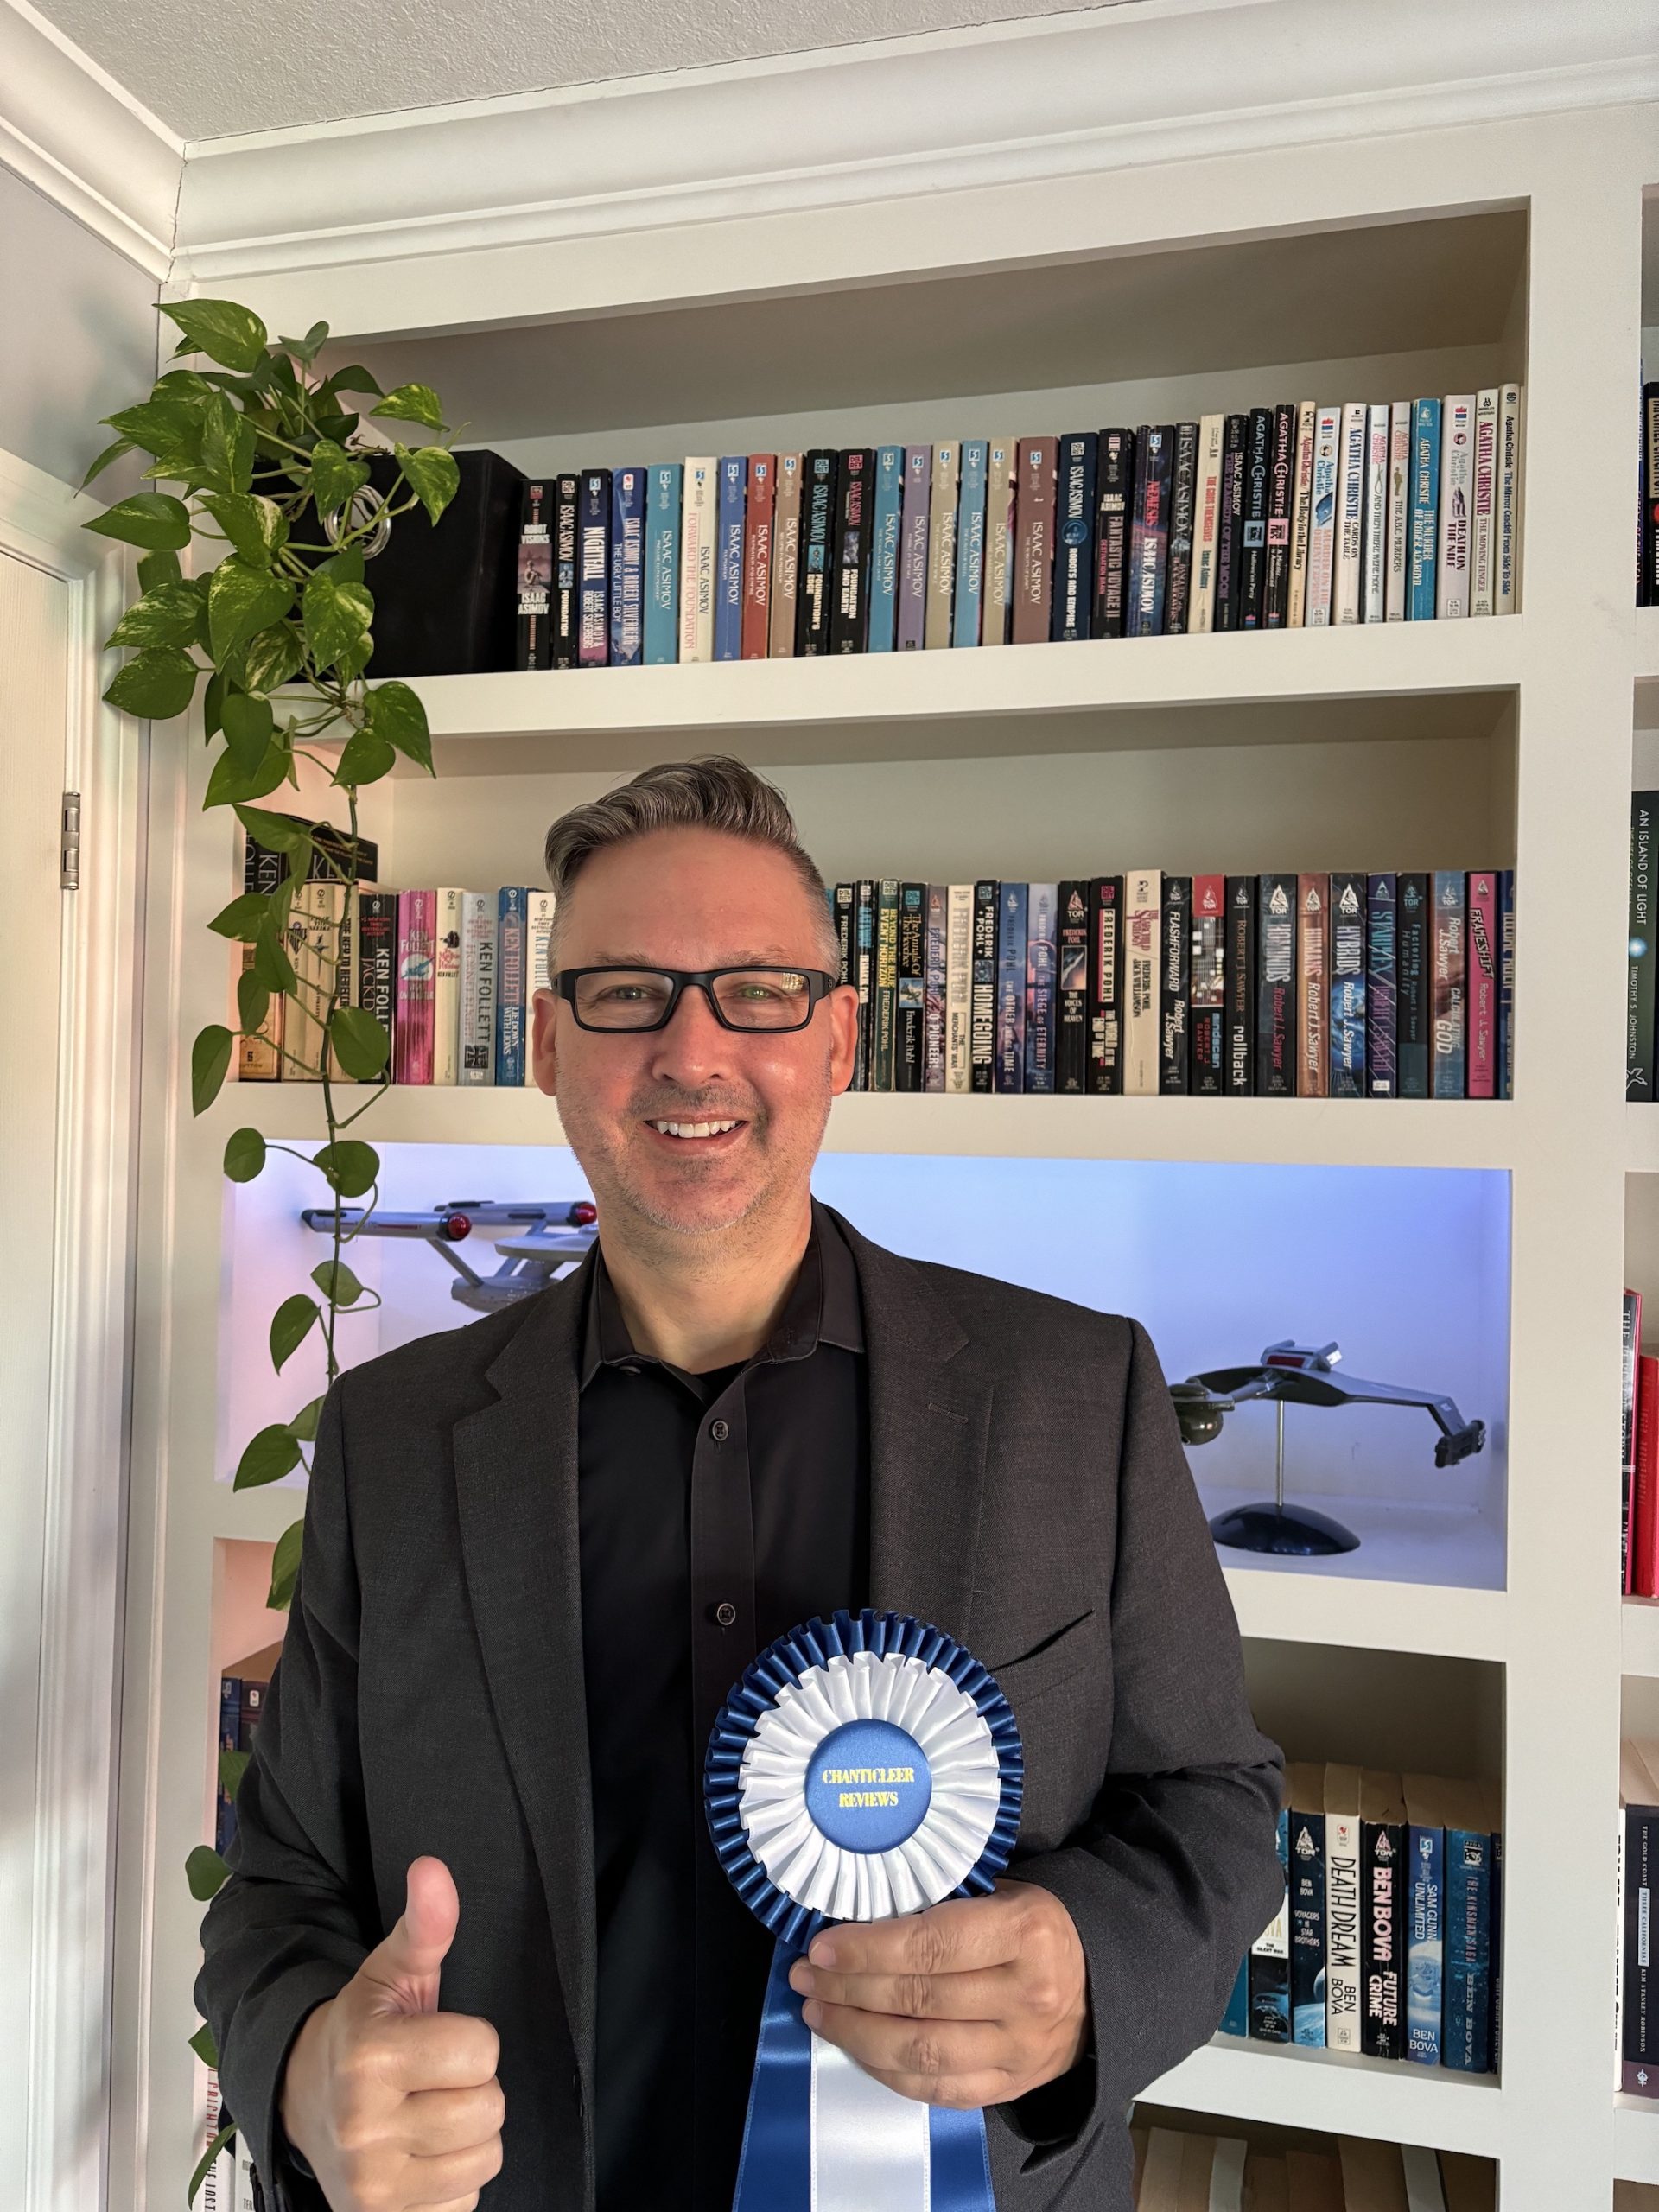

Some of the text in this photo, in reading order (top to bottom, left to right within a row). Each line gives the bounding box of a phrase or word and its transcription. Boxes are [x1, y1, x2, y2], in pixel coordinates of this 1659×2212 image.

[1505, 416, 1514, 442] Agatha
[1251, 416, 1265, 518] AGATHA CHRISTIE
[1274, 413, 1287, 515] AGATHA CHRISTIE
[1346, 428, 1361, 519] AGATHA CHRISTIE
[1477, 422, 1493, 516] AGATHA CHRISTIE
[1504, 442, 1513, 468] Christie
[1146, 480, 1160, 525] NEMESIS
[1232, 453, 1243, 515] ISAAC ASIMOV
[1503, 486, 1512, 509] Mirror
[623, 539, 639, 565] ASIMOV
[624, 518, 640, 537] ISAAC
[1424, 510, 1434, 560] THE MURDER
[1446, 524, 1457, 568] THE NILE
[1457, 520, 1466, 570] DEATH ON
[583, 526, 605, 581] NIGHTFALL
[661, 531, 672, 610] ISAAC ASIMOV
[728, 524, 741, 605] ISAAC ASIMOV
[755, 525, 768, 605] ISAAC ASIMOV
[784, 518, 797, 599] ISAAC ASIMOV
[883, 513, 895, 595] ISAAC ASIMOV
[912, 516, 925, 597] ISAAC ASIMOV
[939, 512, 953, 595] ISAAC ASIMOV
[968, 512, 982, 594] ISAAC ASIMOV
[993, 523, 1007, 606] ISAAC ASIMOV
[1030, 522, 1043, 604] ISAAC ASIMOV
[1107, 516, 1122, 608] FANTASTIC VOYAGE
[1141, 538, 1157, 614] ISAAC ASIMOV
[1351, 547, 1358, 558] ON
[699, 546, 710, 614] ISAAC ASIMOV
[841, 569, 850, 613] AND EARTH
[849, 569, 858, 619] FOUNDATION
[1066, 548, 1077, 627] ROBOTS AND EMPIRE
[560, 590, 569, 636] FOUNDATION
[1637, 810, 1649, 925] AN ISLAND OF LIGHT
[888, 909, 897, 943] BEYOND
[902, 915, 912, 967] The Heechee
[912, 914, 921, 975] The Annals Of
[930, 928, 940, 972] FREDERIK
[984, 906, 993, 957] FREDERIK
[1237, 920, 1246, 961] ROBERT
[1337, 926, 1360, 975] HYBRIDS
[1410, 924, 1421, 976] Factoring
[1470, 908, 1494, 979] FRAMESHIFT
[377, 948, 389, 979] KEN
[480, 942, 493, 971] KEN
[504, 928, 520, 1004] KEN FOLLETT
[879, 944, 888, 987] HORIZON
[1037, 945, 1047, 968] POHL
[1103, 910, 1113, 1001] FREDERIK POHL
[1169, 912, 1180, 992] FLASHFORWARD
[1266, 924, 1291, 982] HOMINIDS
[1304, 928, 1322, 1018] HUMANS Robert
[1402, 930, 1410, 996] Humanity
[887, 966, 895, 988] BLUE
[1037, 988, 1046, 1014] SIEGE
[1236, 973, 1245, 1012] SAWYER
[1343, 982, 1354, 1016] Robert
[1630, 966, 1638, 1001] TIMOTHY
[478, 978, 492, 1042] FOLLETT
[973, 985, 993, 1064] HOMEGOING
[1005, 995, 1014, 1023] OTHER
[1174, 1000, 1185, 1033] Robert
[1274, 988, 1285, 1021] Robert
[1451, 988, 1460, 1048] CALCULATING
[906, 1010, 915, 1063] Frederik Pohl
[929, 1024, 939, 1068] PIONEER!
[1036, 1027, 1046, 1069] ETERNITY
[1233, 1026, 1247, 1085] rollback
[1343, 1029, 1354, 1068] Sawyer
[1437, 1020, 1452, 1054] GOD
[1004, 1052, 1014, 1071] TIME
[823, 1767, 915, 1783] CHANTICLEER
[839, 1791, 899, 1808] REVIEWS
[1301, 1878, 1312, 1887] BEN
[1427, 1885, 1438, 1908] SAM
[1467, 1876, 1478, 1891] THE
[1294, 1910, 1319, 1921] VOYAGERS
[1331, 1856, 1356, 1967] DEATH DREAM
[1373, 1867, 1392, 1961] BEN BOVA
[1415, 1882, 1426, 1939] UNLIMITED
[1466, 1896, 1478, 1937] KINSMAN
[1465, 1939, 1476, 1962] SAGA
[1332, 1978, 1343, 2015] BOVA
[1344, 1986, 1356, 2012] BEN
[1369, 1975, 1382, 2018] CRIME
[1383, 1971, 1397, 2026] FUTURE
[1410, 2040, 1438, 2053] BOVA
[1413, 2029, 1434, 2040] BEN
